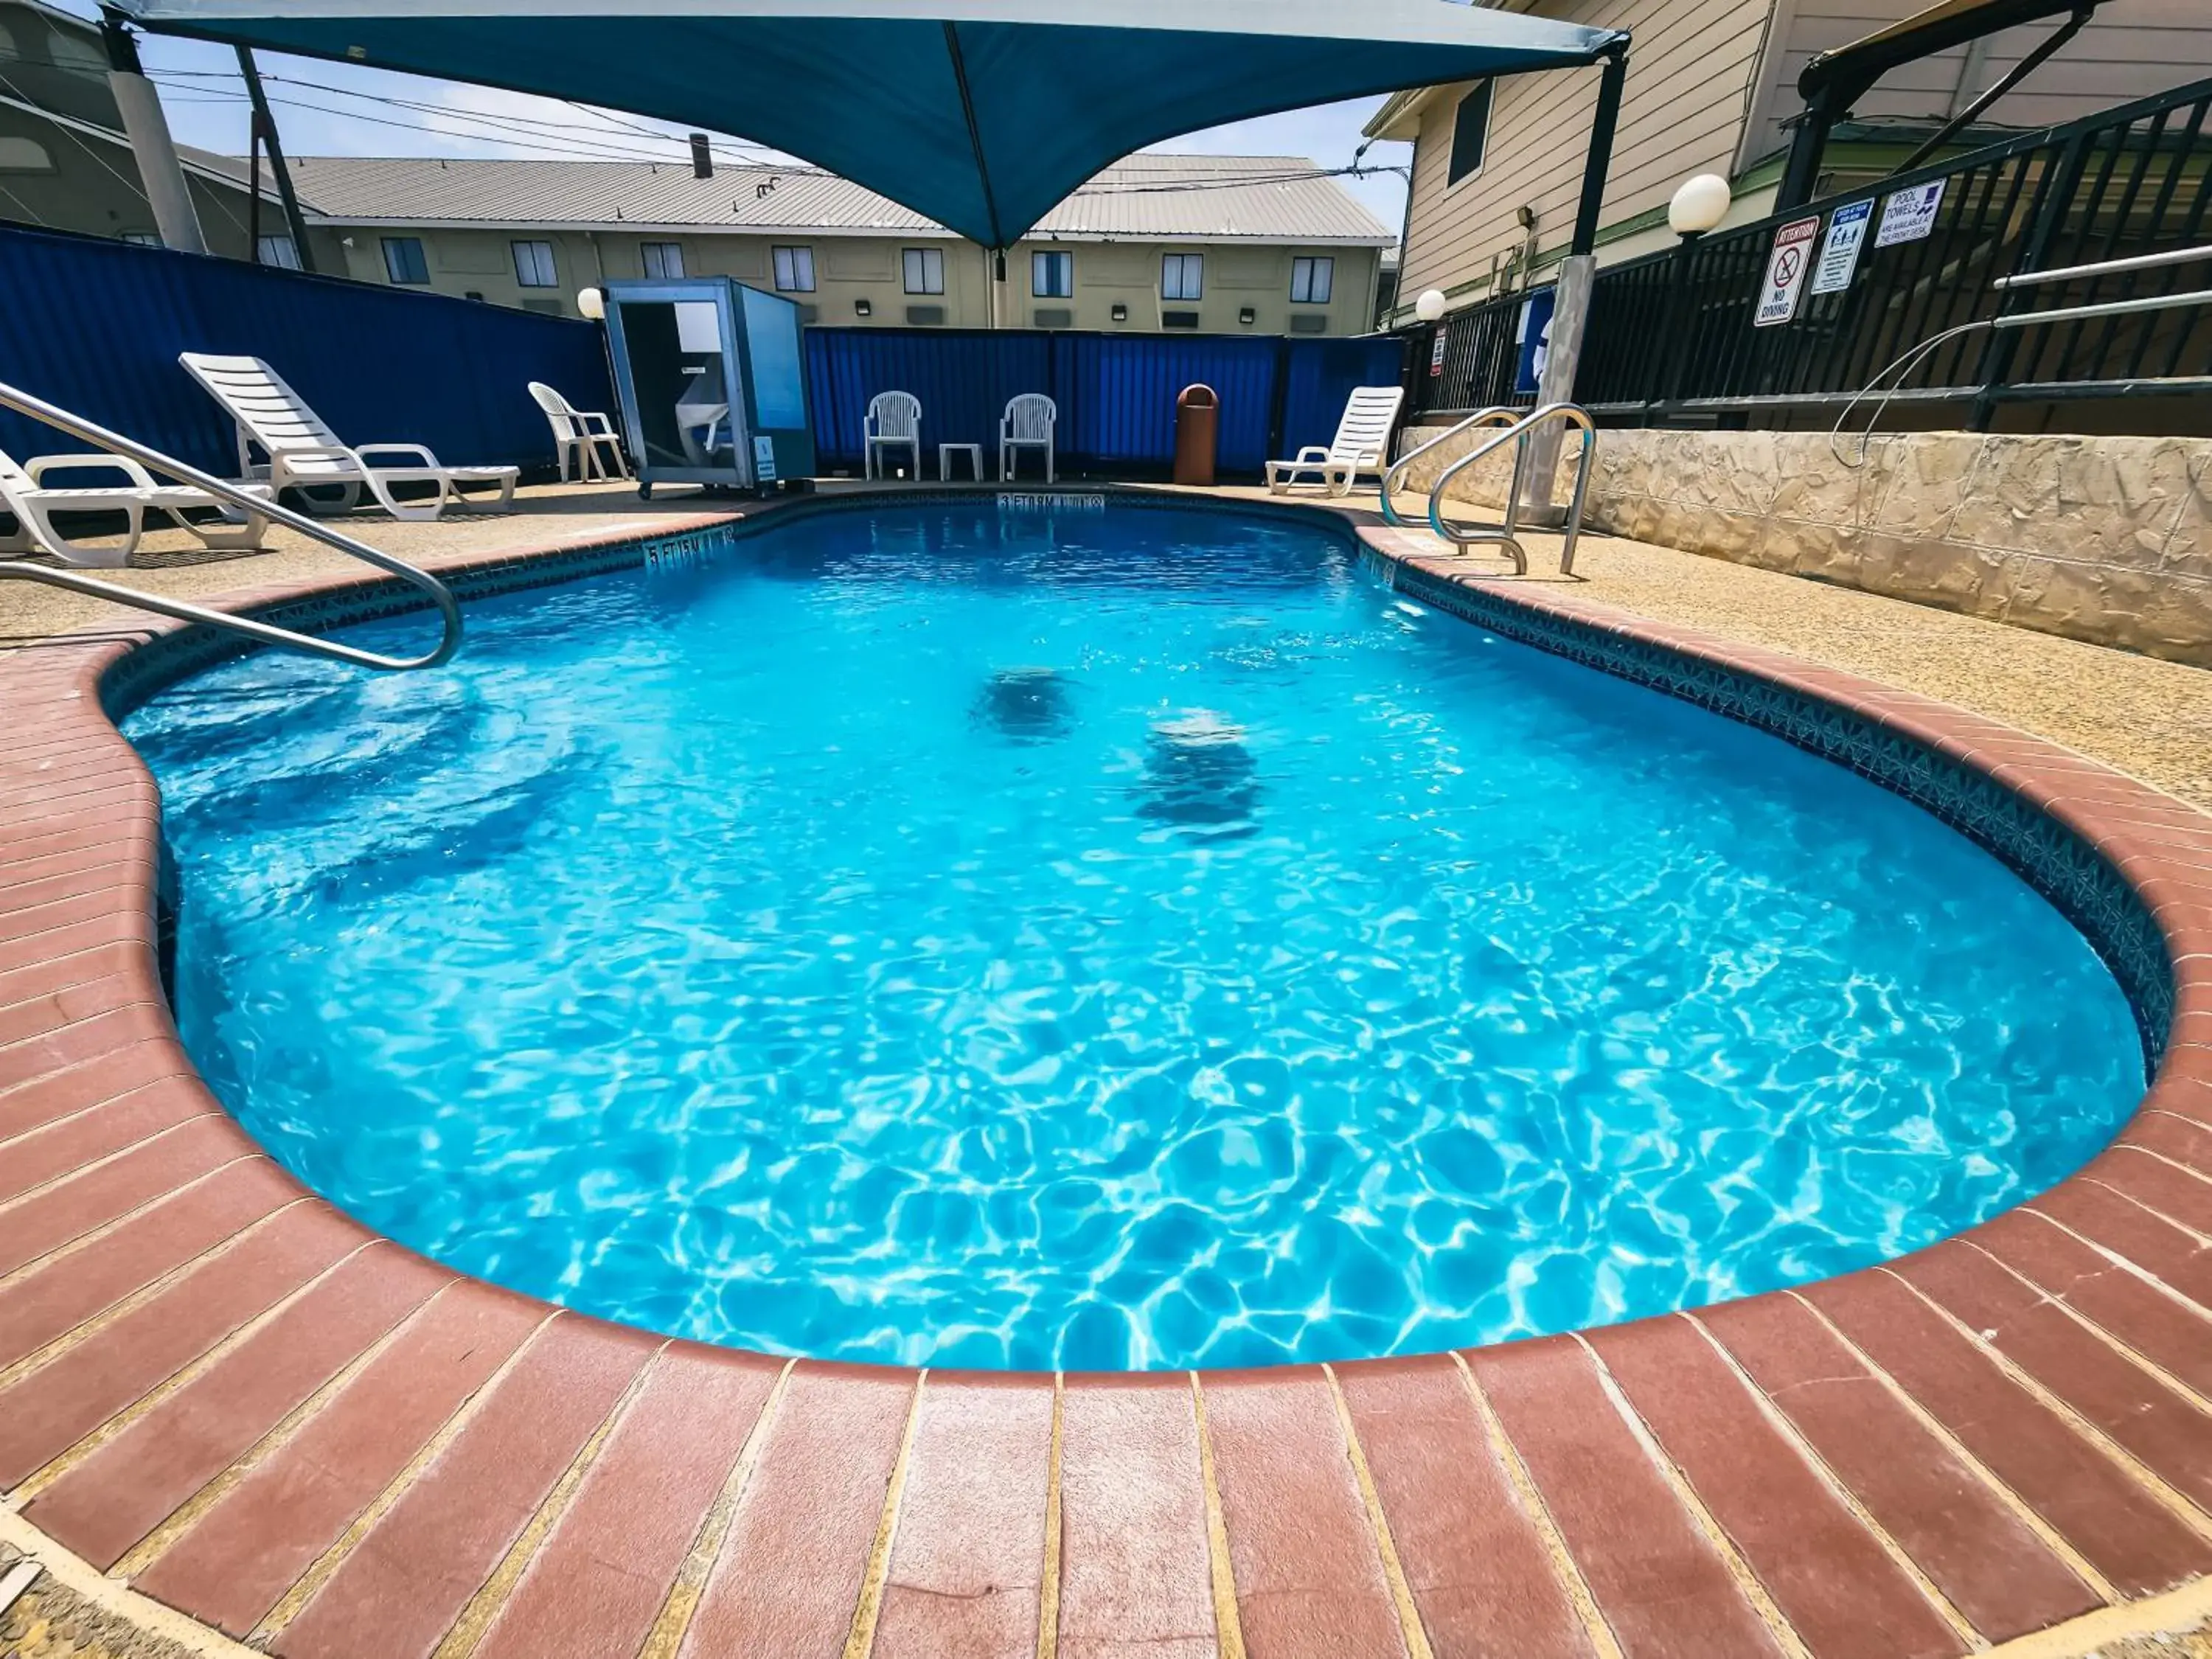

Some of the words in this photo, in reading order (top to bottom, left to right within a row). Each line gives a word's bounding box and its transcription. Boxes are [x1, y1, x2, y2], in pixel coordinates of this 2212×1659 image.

[1895, 190, 1916, 205] POOL
[1887, 201, 1919, 219] TOWELS
[1777, 222, 1815, 244] ATTENTION
[1772, 289, 1785, 302] NO
[1762, 302, 1789, 318] DIVING
[1002, 495, 1009, 507] 3
